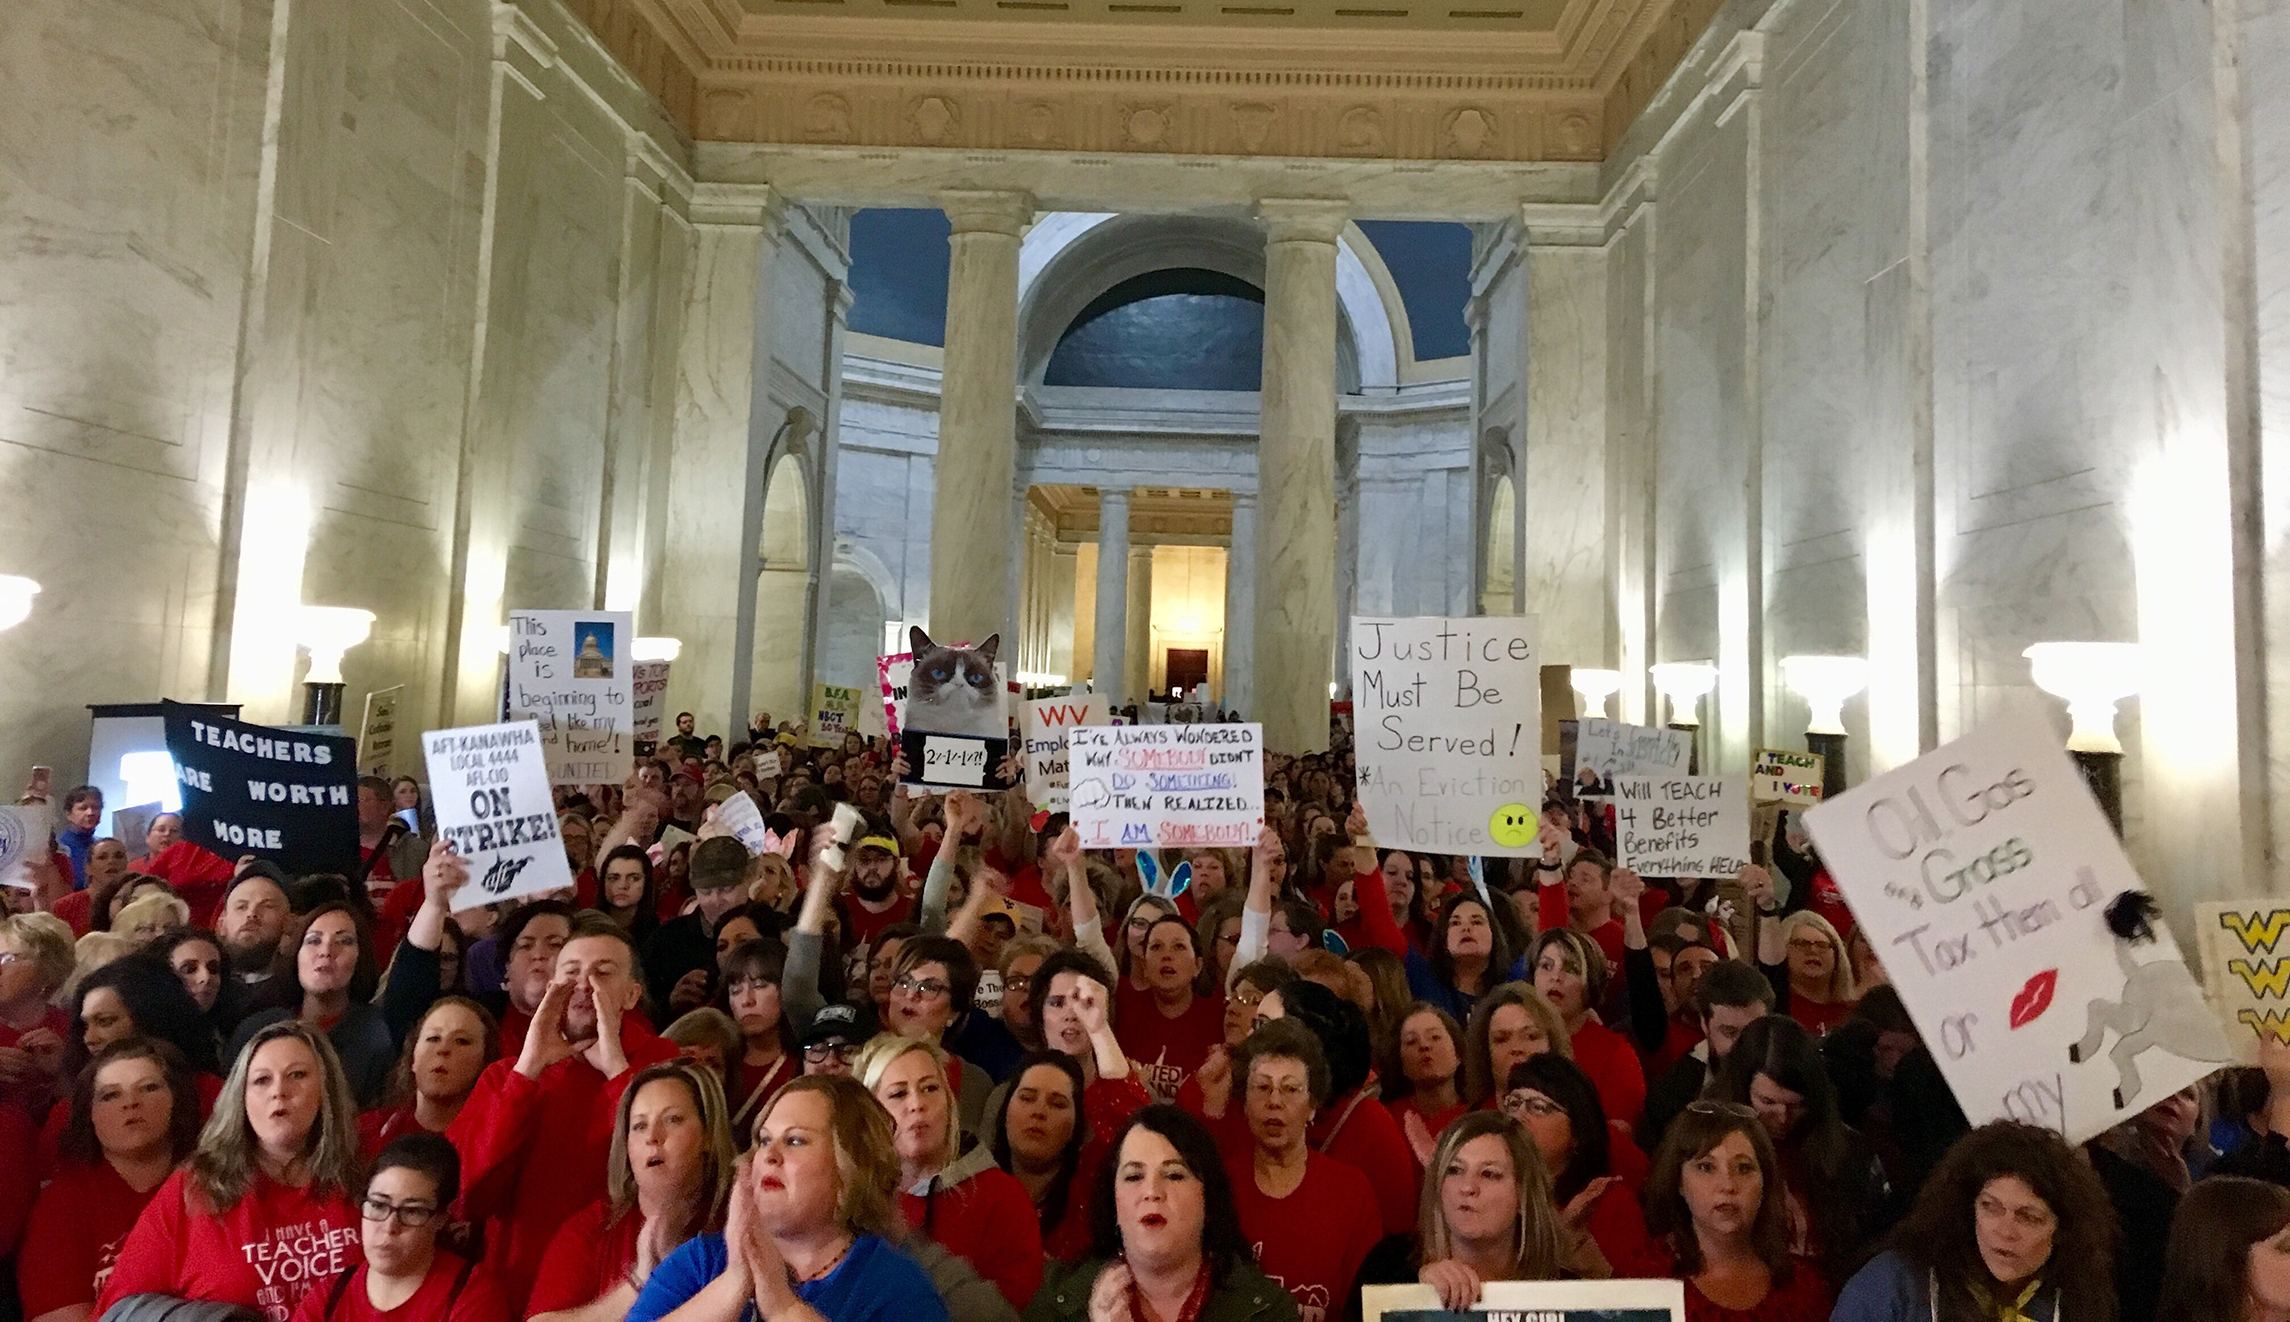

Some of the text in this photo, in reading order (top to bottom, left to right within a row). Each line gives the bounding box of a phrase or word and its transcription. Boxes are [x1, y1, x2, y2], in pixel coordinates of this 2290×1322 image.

[510, 617, 547, 636] This
[519, 639, 557, 663] place
[1358, 621, 1530, 661] Justice
[535, 661, 554, 679] is
[519, 684, 625, 716] beginning to
[1362, 669, 1503, 709] Must Be
[567, 713, 588, 731] like
[593, 717, 616, 743] my
[1038, 704, 1089, 727] WV
[190, 719, 333, 765] TEACHERS
[566, 733, 620, 754] home!
[1114, 729, 1168, 746] ALWAYS
[1176, 726, 1253, 745] WONDERED
[449, 749, 519, 771] LOCAL 4444
[1085, 751, 1112, 768] WHY
[1755, 764, 1784, 777] AND
[1768, 752, 1815, 768] TEACH
[174, 763, 350, 806] ARE WORTH
[1112, 773, 1136, 788] DO
[1418, 768, 1525, 797] Eviction
[1620, 781, 1722, 800] Will TEACH
[1773, 781, 1820, 796] I VOTE
[470, 787, 512, 820] ON
[1113, 794, 1151, 811] THEN
[1091, 820, 1111, 841] I
[1121, 823, 1151, 842] AM
[1395, 802, 1484, 846] Notice
[1620, 807, 1719, 830] 4 Better
[212, 819, 283, 850] MORE
[443, 812, 556, 855] STRIKE!
[1624, 829, 1700, 854] Benefits
[1920, 836, 2034, 904] Grass
[1892, 922, 1977, 977] Tax
[1958, 895, 2062, 947] them
[1940, 1012, 1979, 1060] or
[2002, 1073, 2067, 1137] my
[275, 1221, 313, 1241] HAVE
[241, 1227, 359, 1264] TEACHER
[254, 1248, 346, 1286] VOICE
